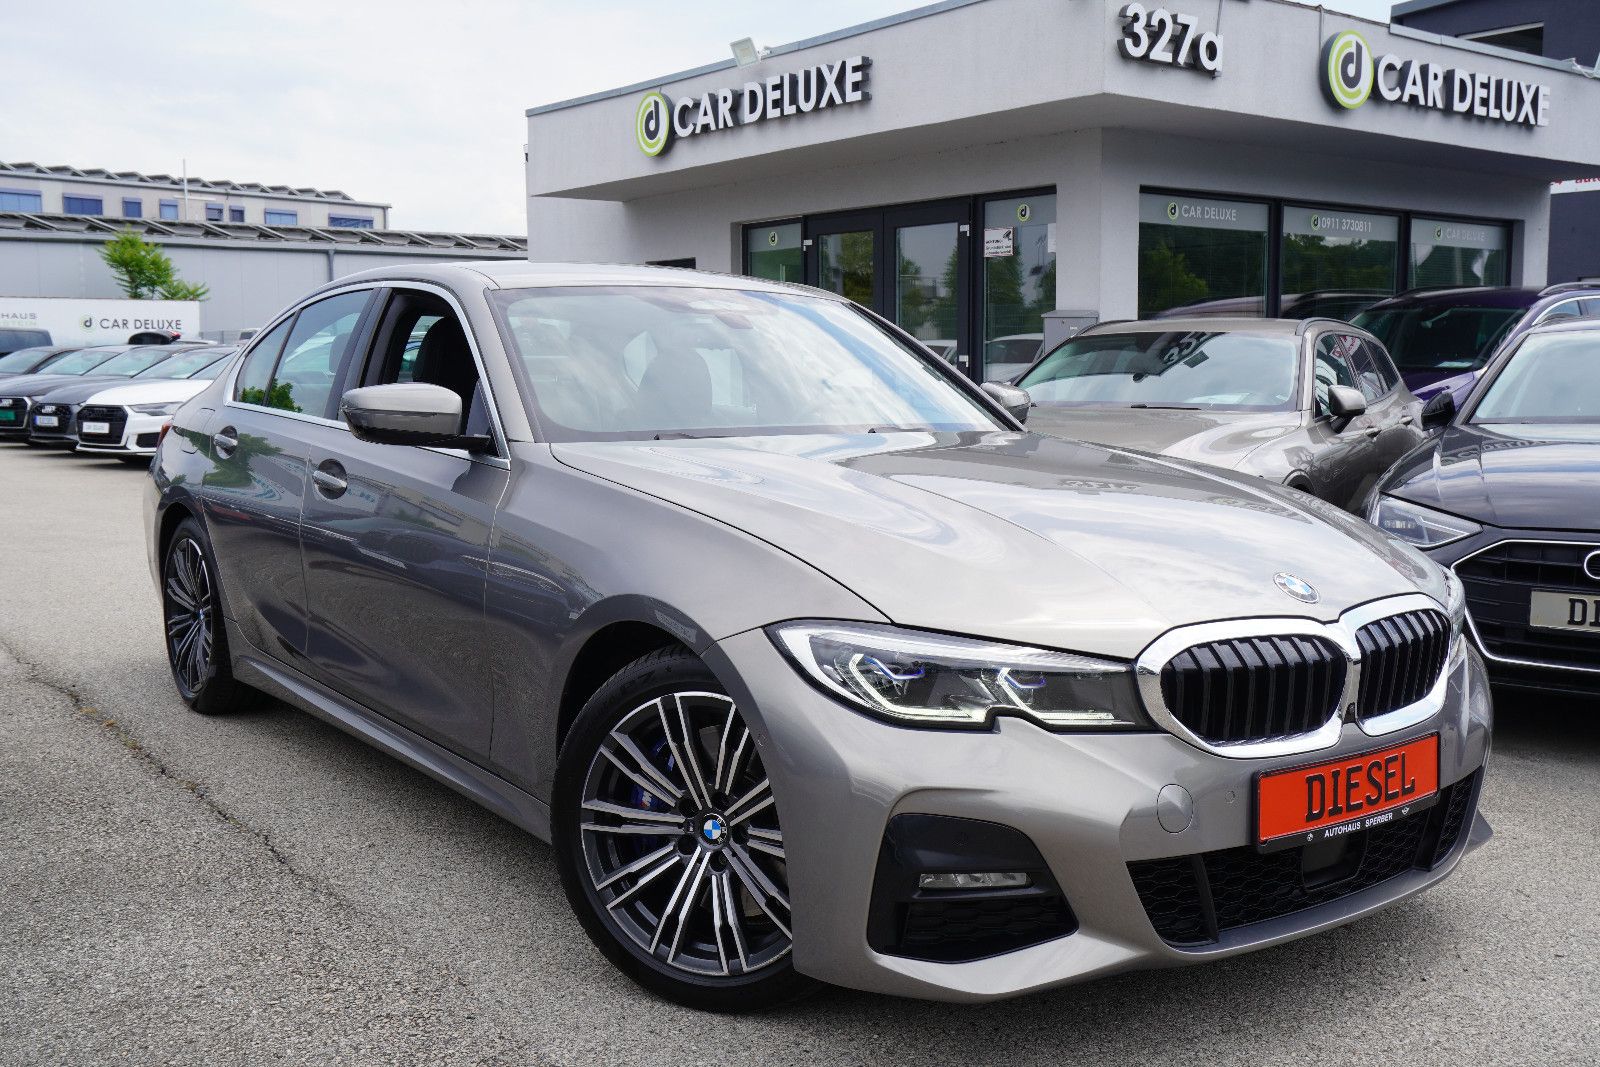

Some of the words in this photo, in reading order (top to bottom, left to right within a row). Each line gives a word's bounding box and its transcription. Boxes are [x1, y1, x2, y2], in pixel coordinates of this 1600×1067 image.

[1122, 2, 1224, 72] 327a
[673, 88, 734, 138] CAR
[744, 55, 865, 124] DELUXE
[1377, 53, 1444, 109] CAR
[1453, 68, 1550, 126] DELUXE
[1181, 205, 1202, 218] CAR
[1204, 206, 1237, 221] DELUXE
[1321, 217, 1339, 230] 0911
[100, 318, 129, 329] CAR
[134, 319, 182, 330] DELUXE
[1305, 751, 1416, 823] DIESEL
[1324, 821, 1361, 838] AUTOHAUS
[1365, 812, 1393, 828] SPERBER
